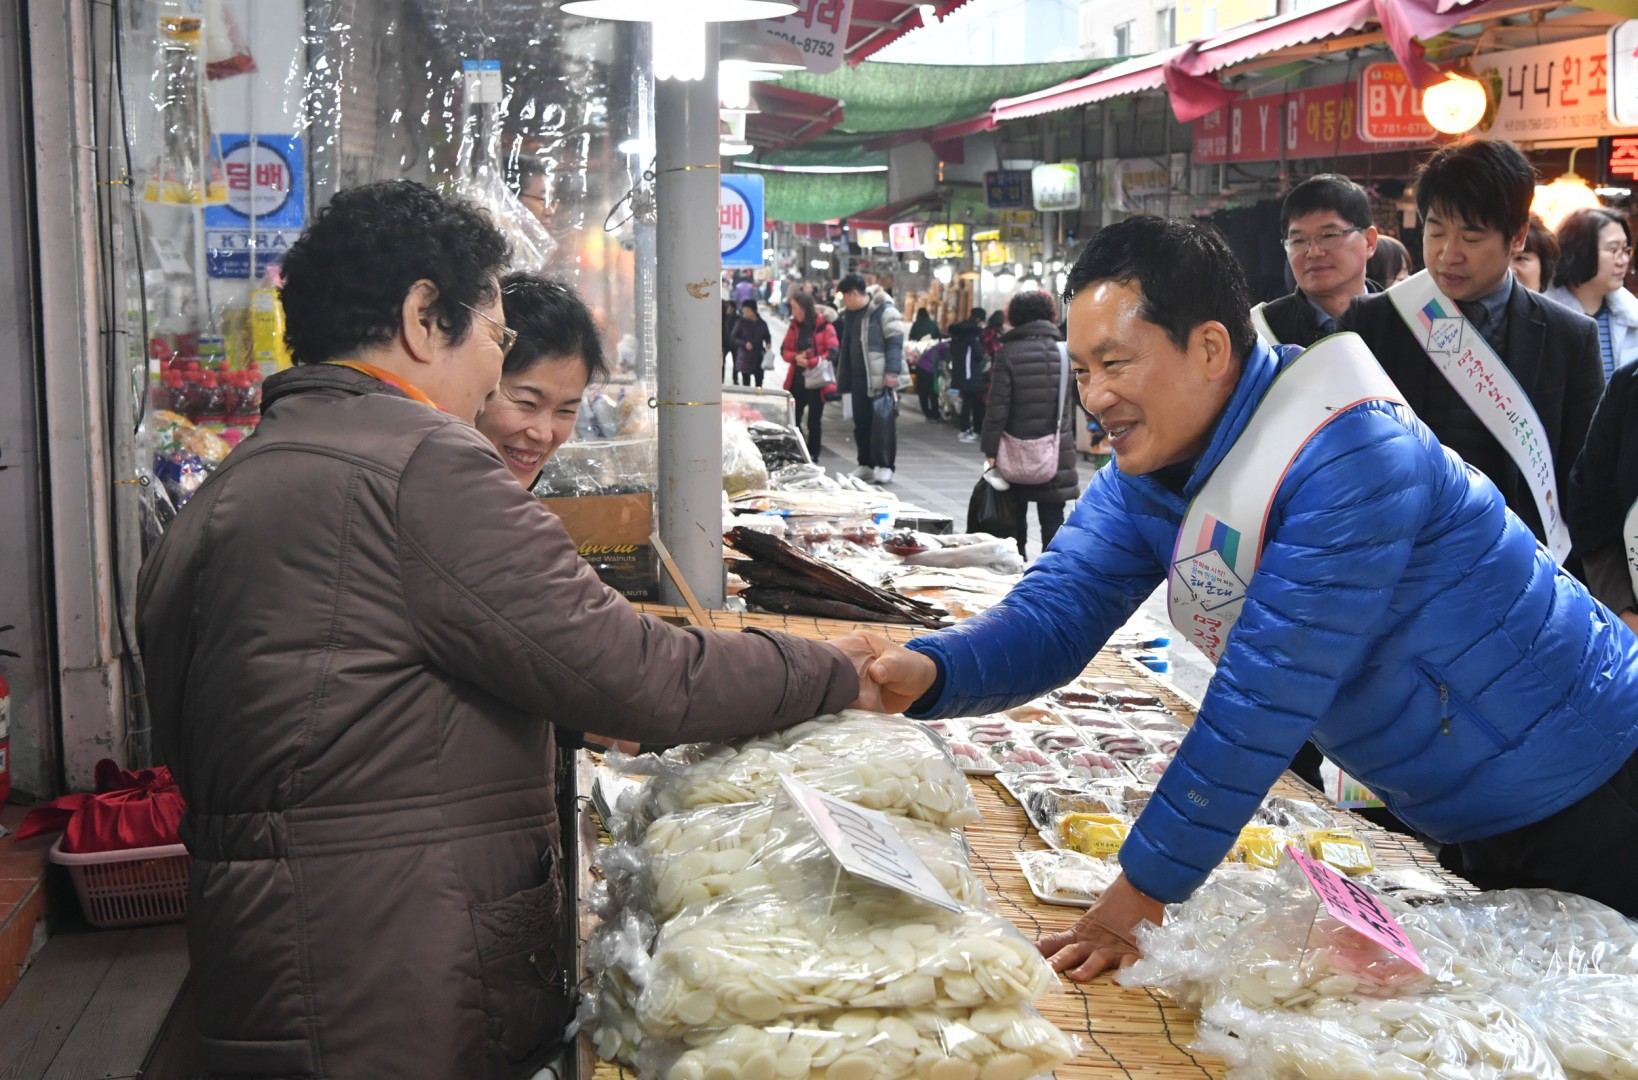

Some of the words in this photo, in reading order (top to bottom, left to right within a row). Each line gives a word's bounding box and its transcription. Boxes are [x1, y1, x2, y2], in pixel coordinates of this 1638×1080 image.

[226, 163, 283, 192] 담배
[1190, 575, 1232, 597] 해운대
[1187, 789, 1210, 808] 800
